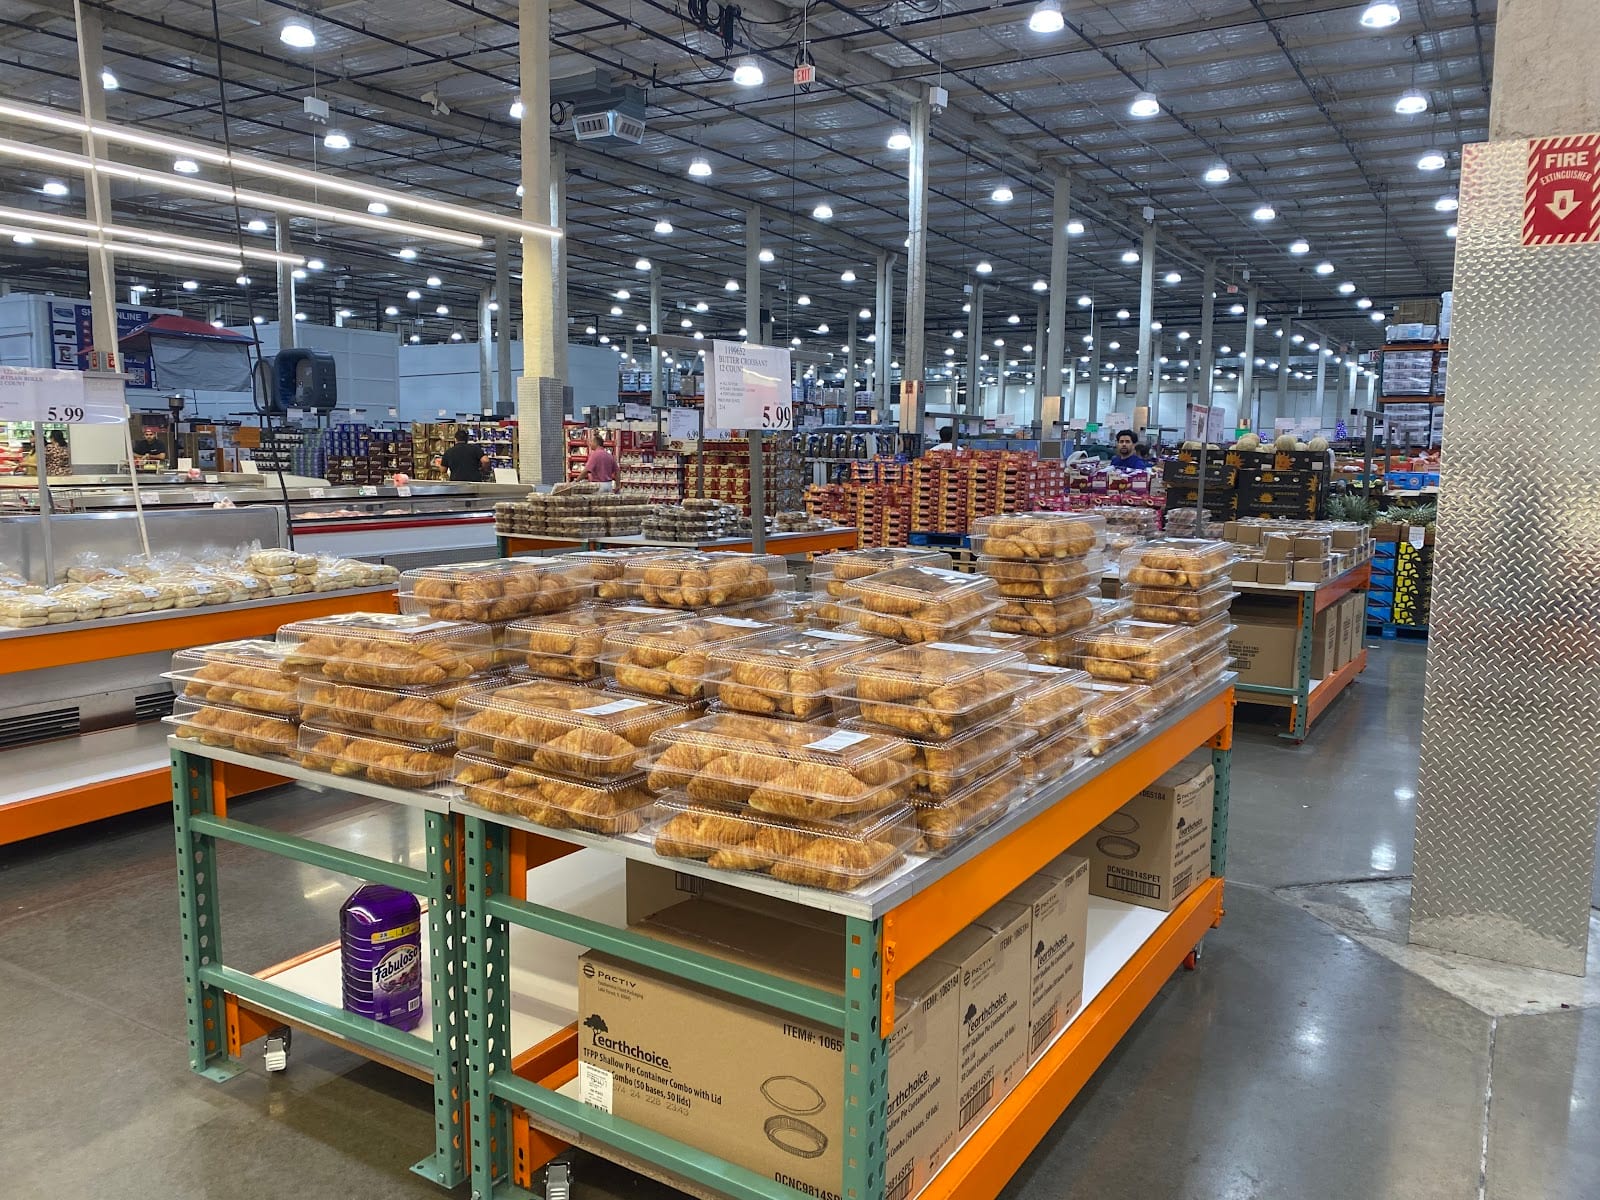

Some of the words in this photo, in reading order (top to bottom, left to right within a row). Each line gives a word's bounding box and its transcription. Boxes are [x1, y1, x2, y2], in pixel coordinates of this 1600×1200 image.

[796, 69, 810, 82] EXIT
[1545, 151, 1590, 169] FIRE
[1540, 170, 1593, 186] EXTINGUISHER
[116, 312, 142, 322] NLINE
[719, 355, 740, 365] BUTTER
[740, 357, 768, 368] CROISSANT
[48, 406, 84, 422] 5.99
[763, 405, 791, 429] 5.99
[687, 430, 699, 439] 6.99
[374, 946, 418, 983] Fabuloso
[971, 956, 993, 976] PACTIV
[598, 970, 637, 989] PACTIV
[970, 992, 1008, 1032] earthchoice
[783, 1023, 816, 1045] ITEM#:
[818, 1035, 845, 1053] 1065
[888, 1023, 909, 1044] ACTIV
[583, 1047, 599, 1060] TFPP
[599, 1053, 624, 1070] Shallow
[625, 1062, 636, 1074] Pie
[636, 1066, 669, 1087] Container
[669, 1078, 693, 1095] Combo
[693, 1086, 710, 1101] with
[711, 1092, 722, 1105] Lid
[612, 1070, 633, 1087] Combo
[633, 1077, 645, 1091] (50
[645, 1083, 666, 1100] bases,
[667, 1091, 676, 1101] 50
[676, 1095, 691, 1109] lids)
[887, 1070, 929, 1116] arthchoice
[908, 1089, 929, 1113] Container
[928, 1076, 941, 1095] Combo
